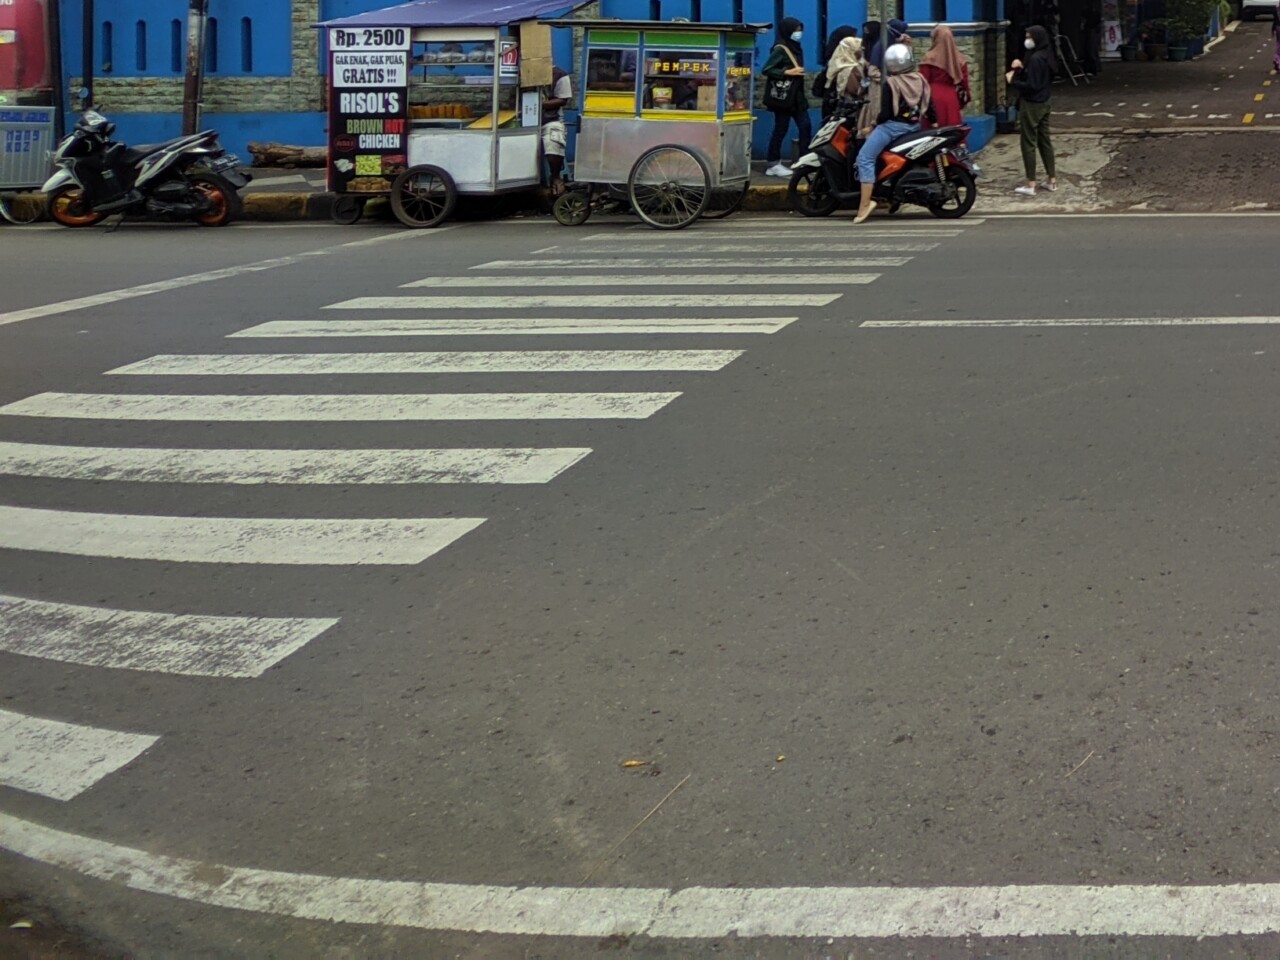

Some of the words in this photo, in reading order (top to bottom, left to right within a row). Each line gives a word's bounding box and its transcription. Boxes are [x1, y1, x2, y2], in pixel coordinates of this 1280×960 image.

[336, 29, 360, 48] Rp.
[363, 29, 405, 46] 2500
[335, 55, 348, 65] GAK
[370, 55, 384, 65] GAK
[655, 62, 710, 72] PEMPEK
[343, 68, 384, 84] GRATIS
[340, 92, 399, 113] RISOL'S
[346, 119, 383, 134] BROWN
[359, 134, 400, 149] CHICKEN
